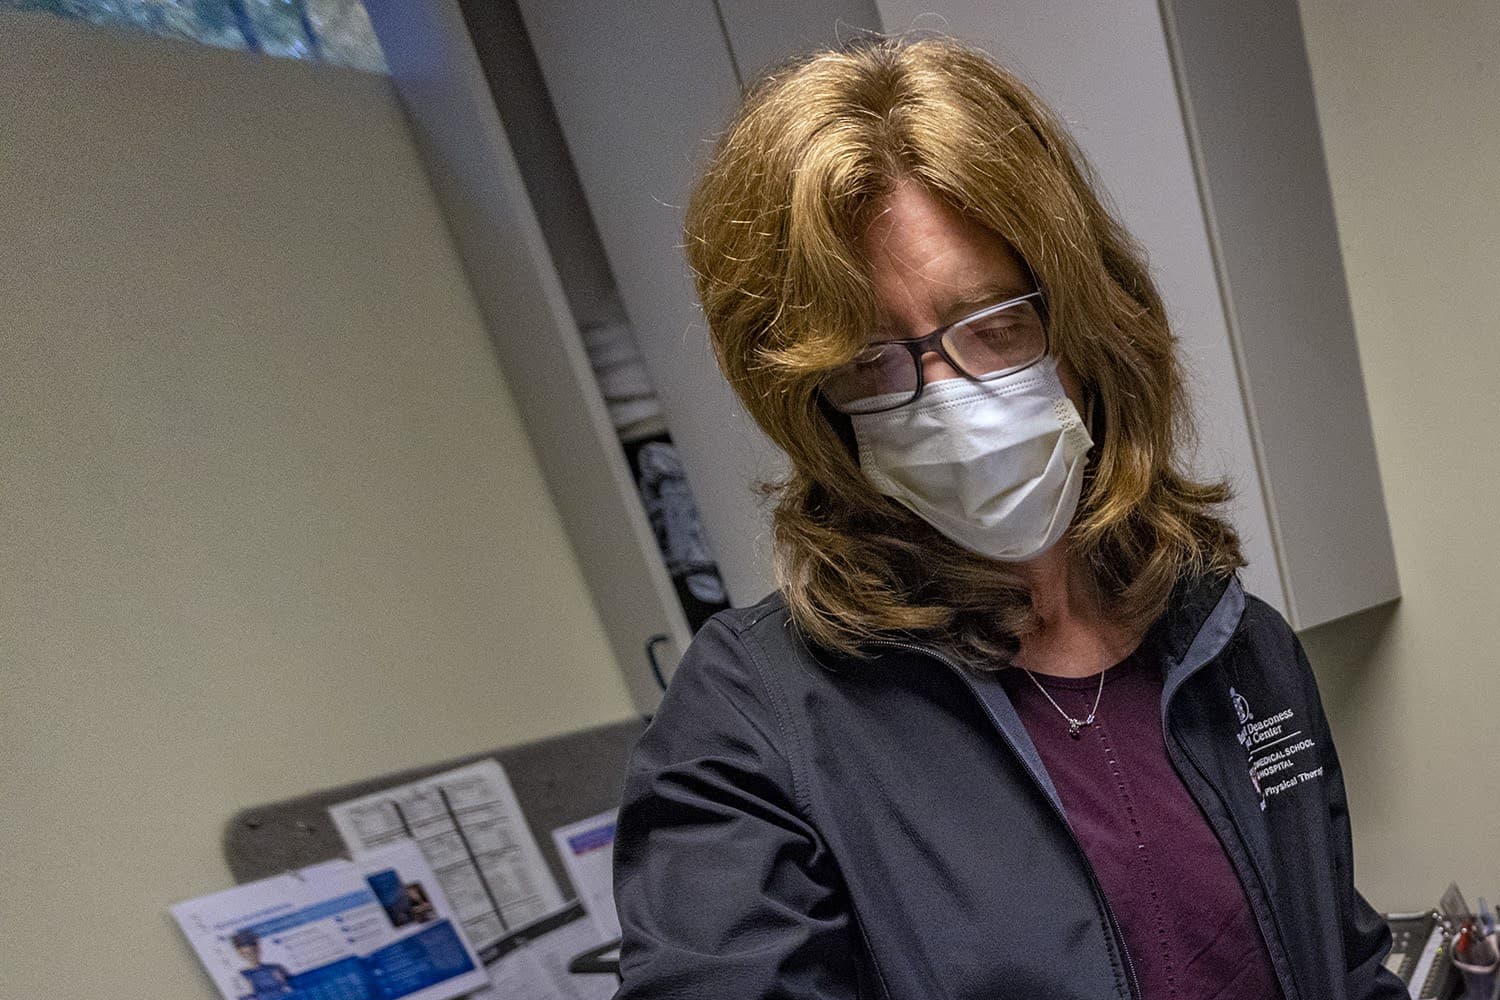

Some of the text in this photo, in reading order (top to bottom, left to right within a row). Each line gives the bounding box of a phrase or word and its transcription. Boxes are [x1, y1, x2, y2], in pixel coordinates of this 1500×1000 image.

[1247, 708, 1294, 734] Deaconess
[1252, 725, 1282, 744] Center
[1285, 738, 1316, 757] SCHOOL
[1259, 760, 1294, 778] HOSPITAL
[1264, 777, 1298, 796] Physical
